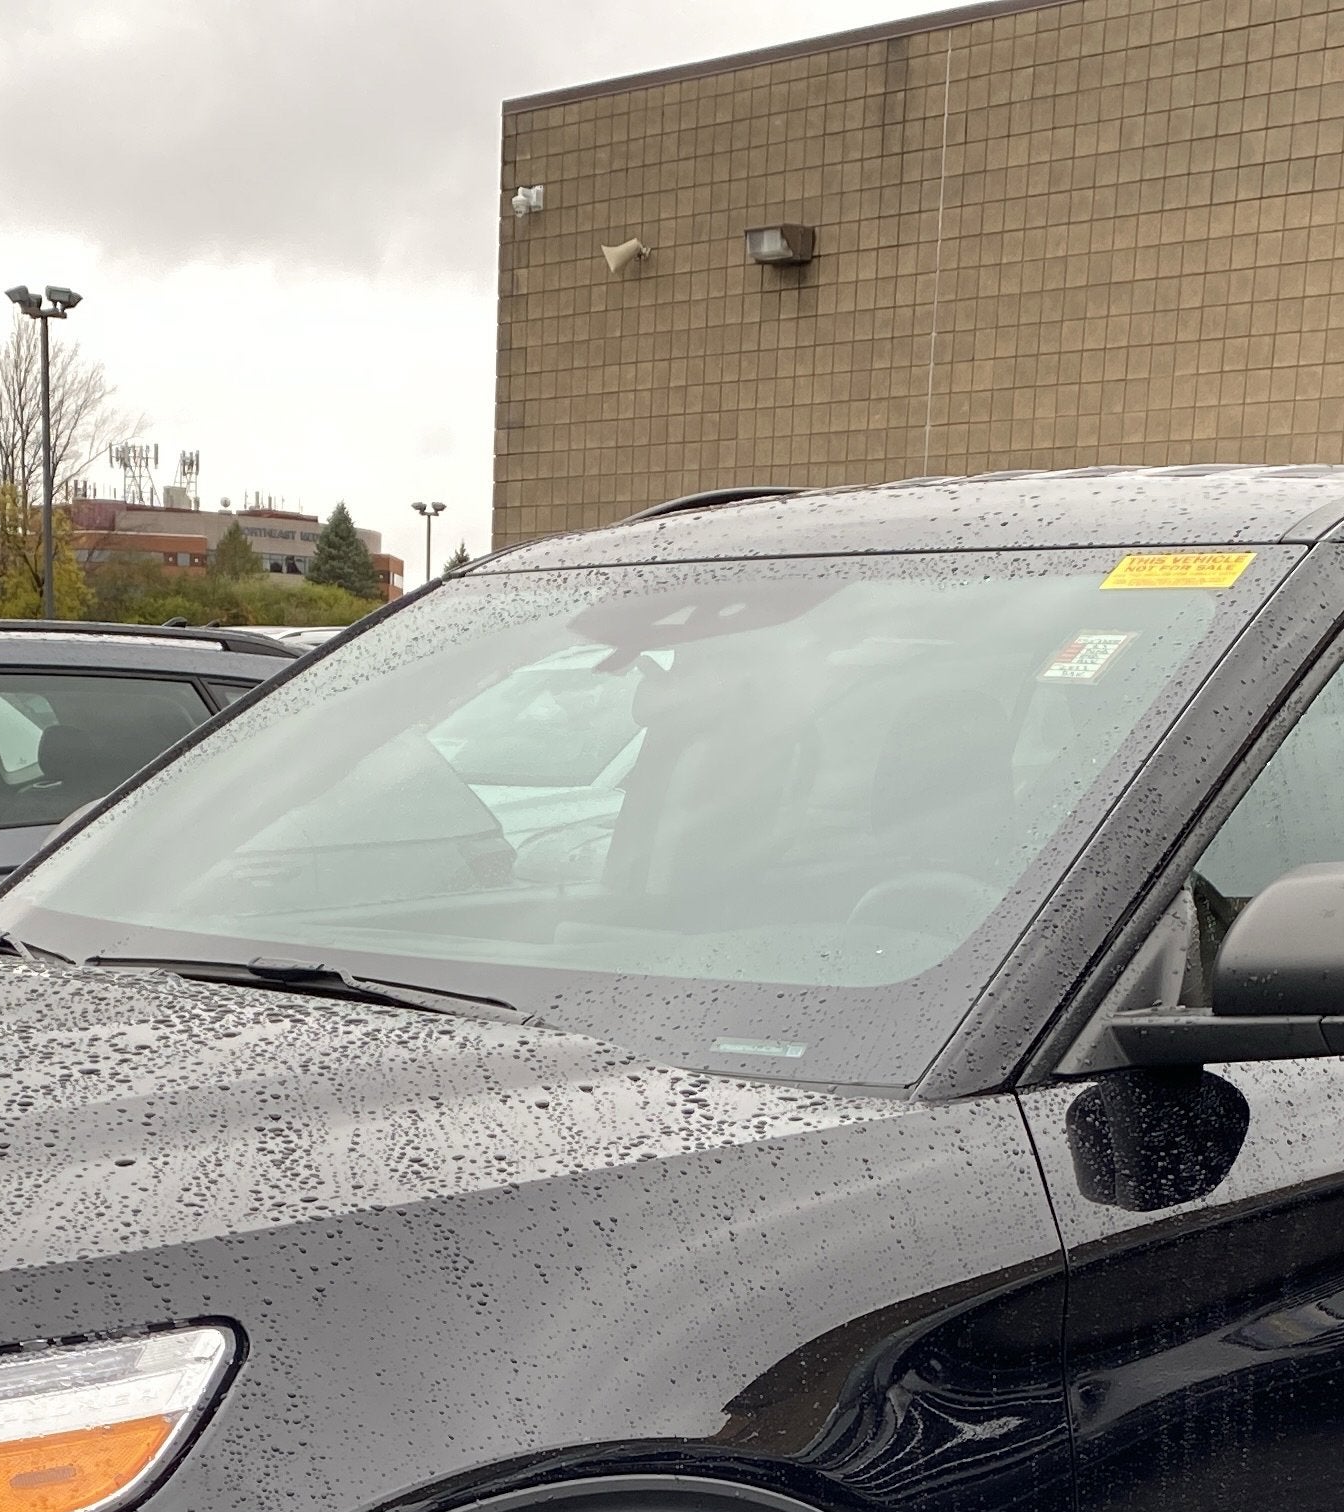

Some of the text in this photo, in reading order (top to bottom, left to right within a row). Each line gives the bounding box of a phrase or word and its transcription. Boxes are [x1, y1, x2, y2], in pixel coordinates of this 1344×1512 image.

[242, 527, 296, 540] ORTHEAST
[1129, 554, 1249, 565] THIS VEHICLE
[1124, 563, 1236, 572] NOT FOR SALE
